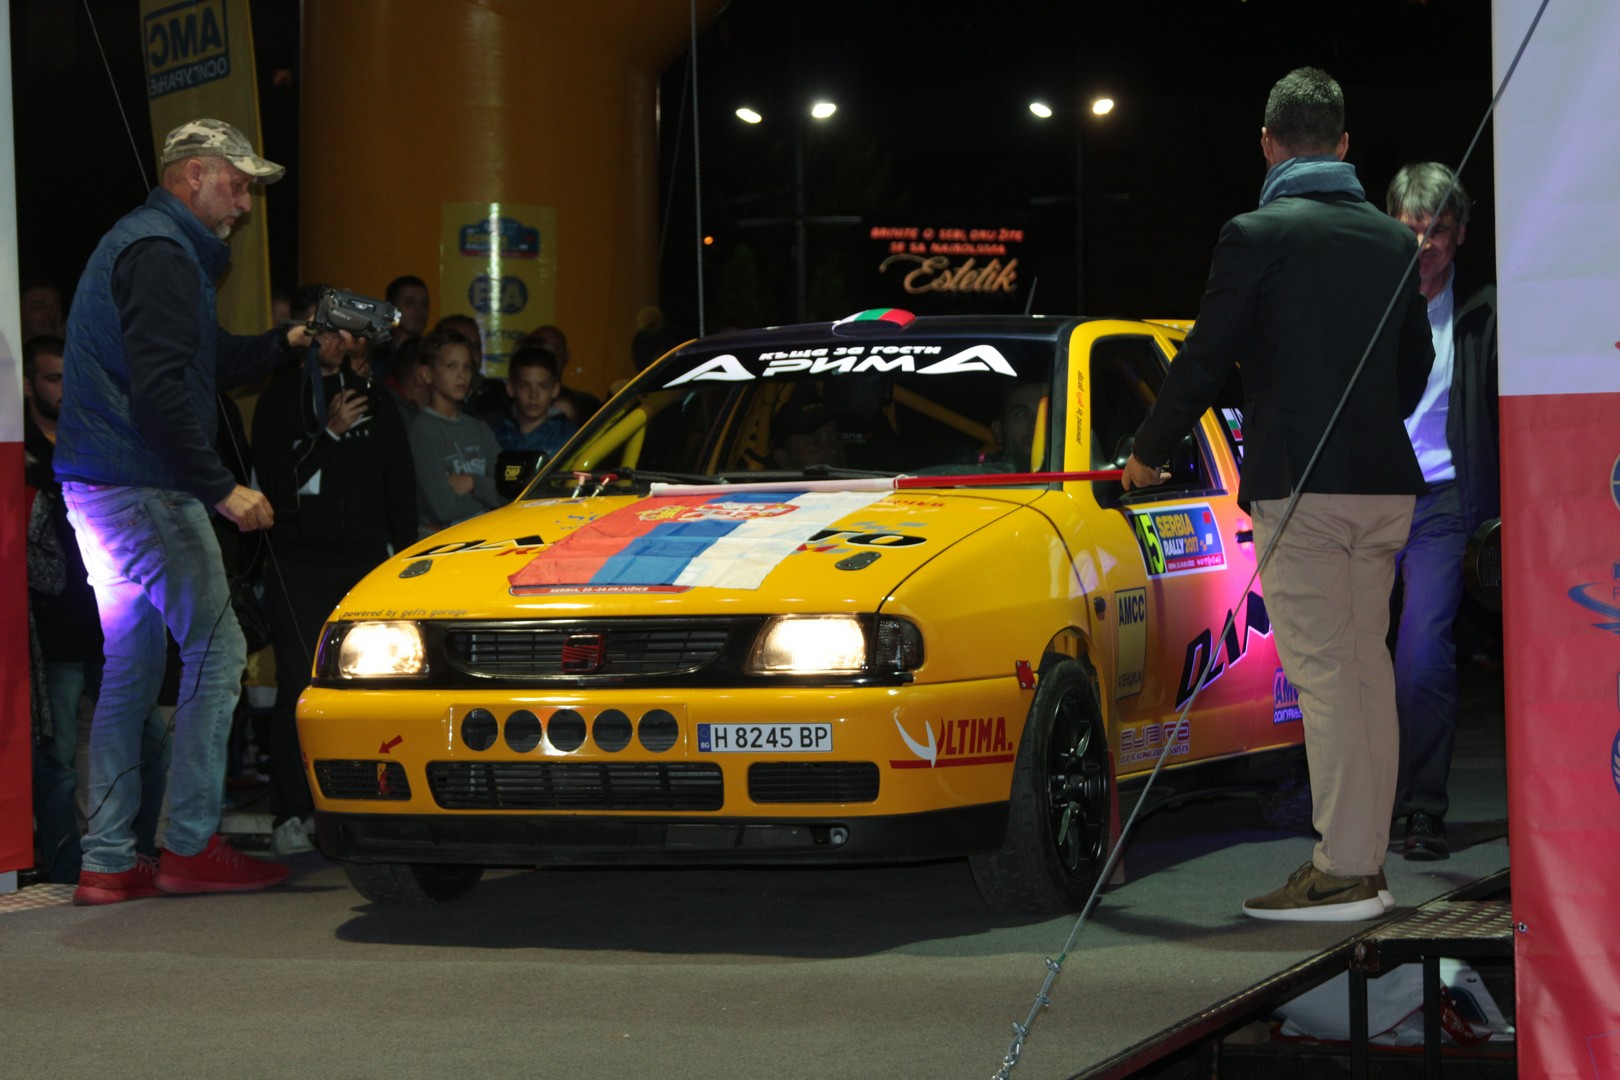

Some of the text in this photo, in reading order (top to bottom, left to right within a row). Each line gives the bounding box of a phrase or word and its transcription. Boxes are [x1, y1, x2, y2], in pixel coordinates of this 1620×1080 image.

[879, 253, 1018, 294] Estetik
[1155, 513, 1195, 538] SERBIA
[1134, 514, 1164, 574] 15
[1163, 536, 1199, 556] RALLY 2017
[342, 608, 384, 618] powered
[386, 608, 398, 618] by
[430, 608, 468, 617] garage
[700, 741, 710, 749] BG
[714, 726, 828, 748] H 8245 BP
